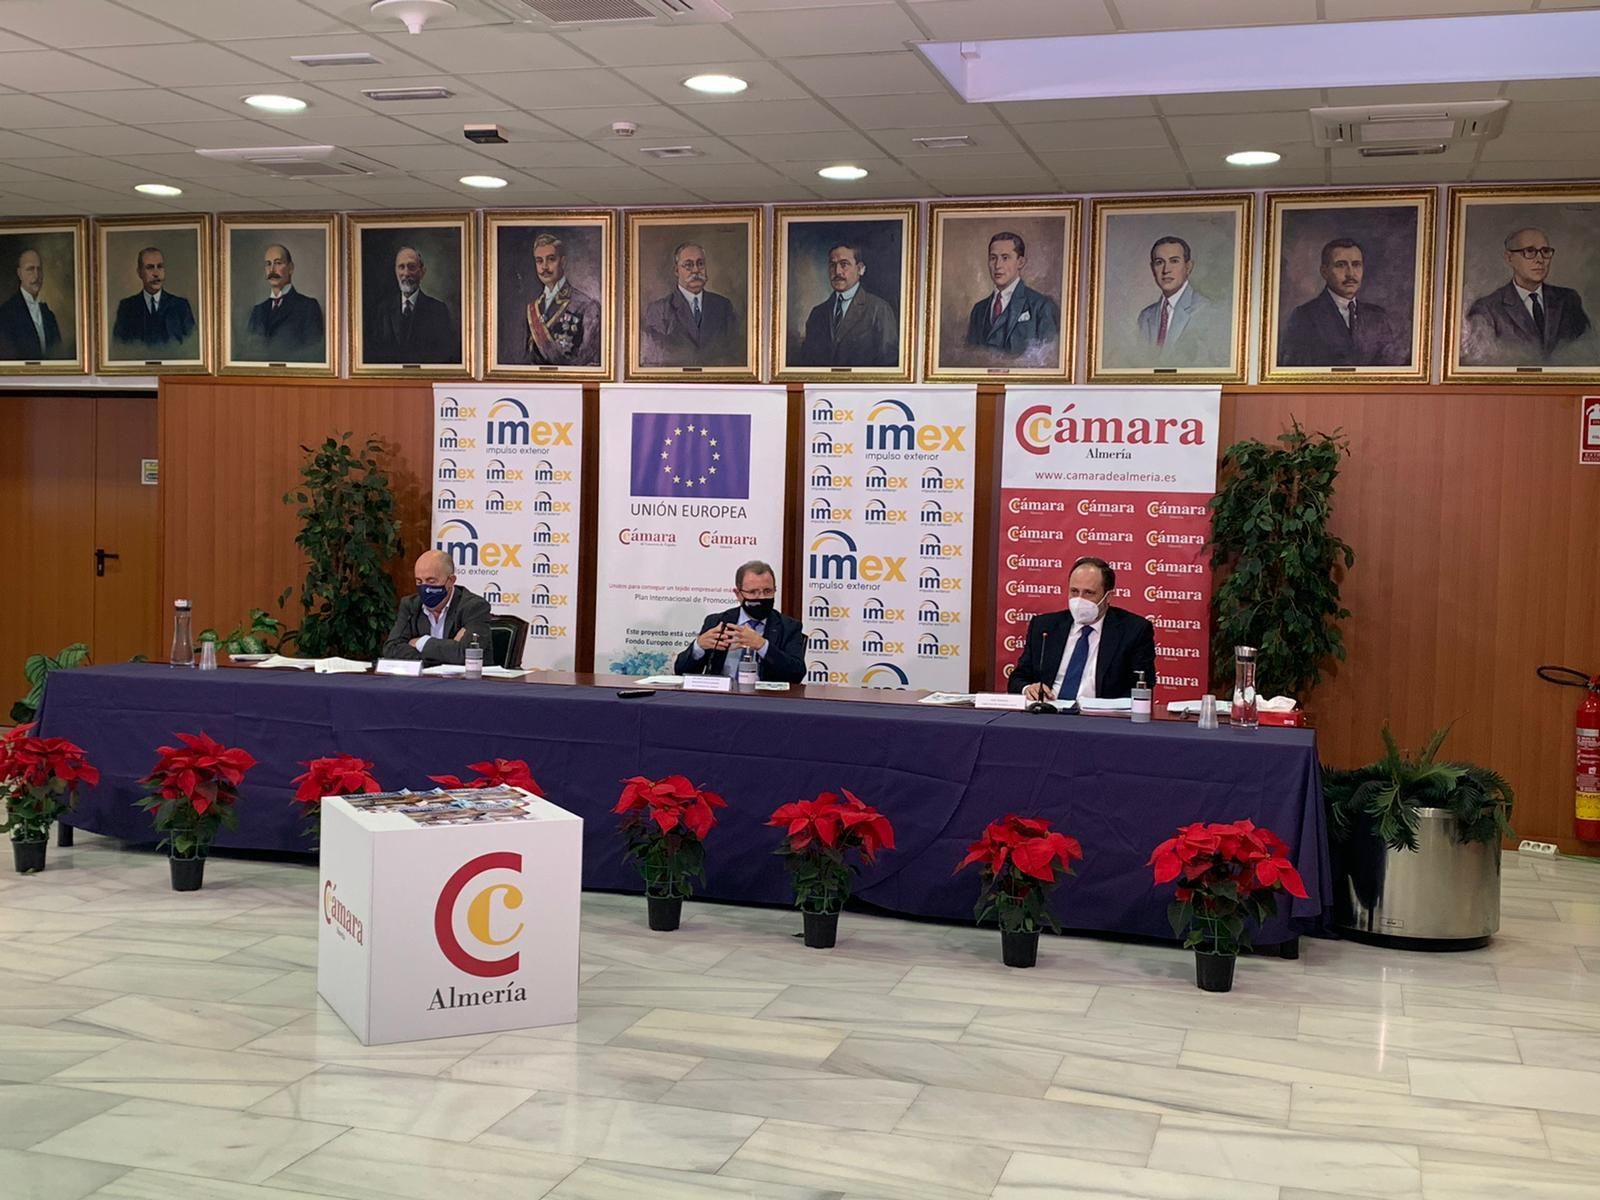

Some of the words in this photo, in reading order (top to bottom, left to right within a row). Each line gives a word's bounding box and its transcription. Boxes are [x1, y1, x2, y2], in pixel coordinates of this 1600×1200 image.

[441, 407, 476, 417] imex
[813, 409, 854, 420] imex
[487, 421, 573, 446] imex
[1016, 402, 1205, 455] Cámara
[440, 438, 476, 448] imex
[866, 424, 965, 450] imex
[486, 447, 517, 456] impulso
[812, 443, 853, 454] imex
[1086, 448, 1132, 460] Almería
[866, 452, 900, 462] impulso
[904, 452, 939, 461] exterior
[439, 468, 475, 479] imex
[487, 469, 523, 480] imex
[535, 470, 572, 480] imex
[1035, 471, 1176, 483] www.camaradealmeria.es
[812, 476, 852, 487] imex
[866, 476, 907, 488] imex
[922, 478, 964, 489] imex
[438, 499, 474, 509] imex
[486, 500, 522, 510] imex
[534, 501, 570, 512] imex
[631, 502, 677, 516] UNIÓN
[682, 505, 747, 518] EUROPEA
[1009, 498, 1064, 514] Cámara
[1077, 500, 1134, 515] Cámara
[1147, 502, 1205, 517] Cámara
[811, 508, 852, 520] imex
[865, 509, 907, 521] imex
[921, 511, 963, 522] imex
[534, 532, 569, 543] imex
[618, 528, 676, 545] Cámara
[699, 530, 757, 548] Cámara
[1008, 526, 1063, 542] Cámara
[1076, 528, 1133, 544] Cámara
[1146, 530, 1204, 546] Cámara
[920, 544, 962, 556] imex
[810, 554, 906, 582] imex
[1007, 554, 1062, 570] Cámara
[1145, 559, 1203, 575] Cámara
[533, 563, 568, 574] imex
[809, 581, 843, 590] impulso
[847, 582, 880, 591] exterior
[919, 577, 961, 589] imex
[1006, 580, 1061, 596] Cámara
[484, 592, 520, 603] imex
[532, 594, 567, 604] imex
[1144, 586, 1202, 602] Cámara
[809, 606, 850, 617] imex
[863, 608, 904, 620] imex
[919, 610, 960, 622] imex
[531, 625, 566, 636] imex
[808, 638, 849, 650] imex
[863, 641, 904, 653] imex
[918, 643, 960, 656] imex
[1155, 643, 1200, 658] ámara
[808, 671, 848, 683] imex
[324, 880, 363, 946] Cámara
[426, 981, 527, 1011] Almería
